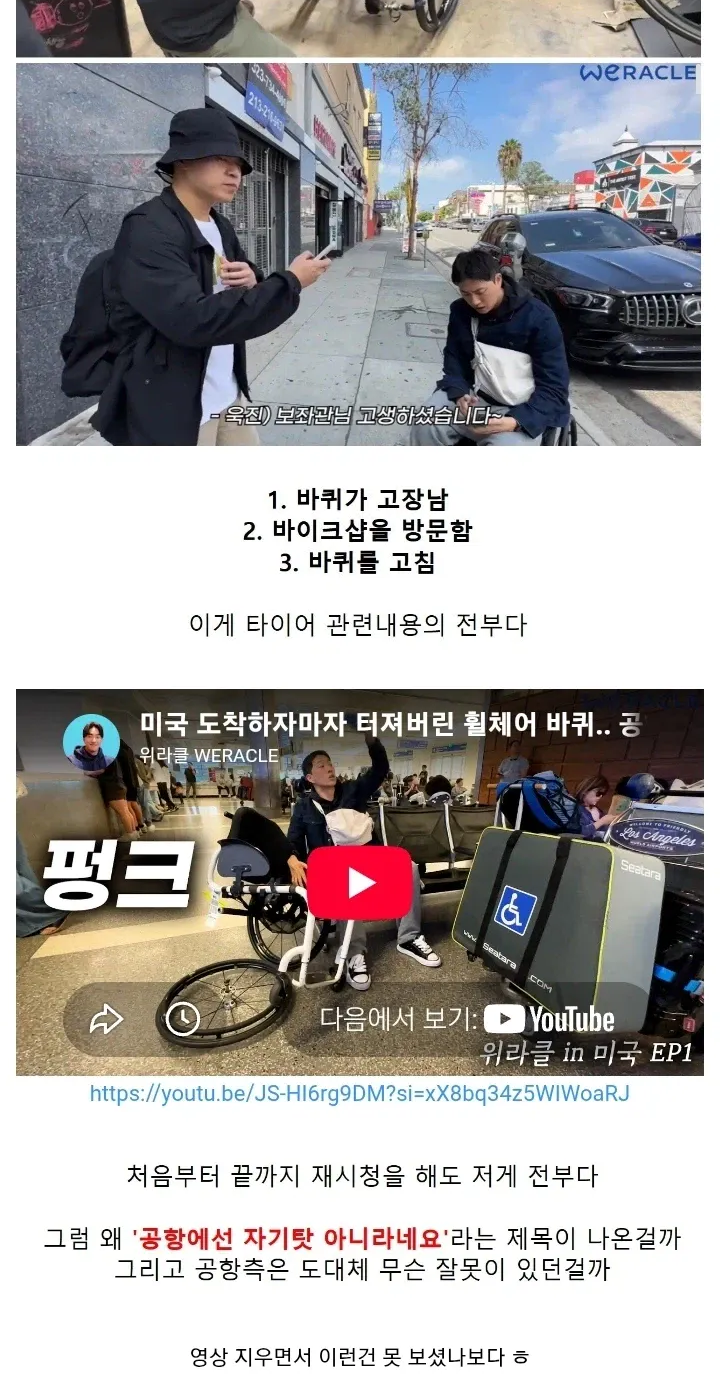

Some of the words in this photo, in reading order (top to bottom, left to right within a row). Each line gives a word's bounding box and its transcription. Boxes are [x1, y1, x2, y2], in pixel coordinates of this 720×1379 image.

[620, 827, 640, 840] Los
[642, 831, 697, 847] Angeles
[621, 859, 661, 881] Seatara
[482, 942, 517, 970] Seatara
